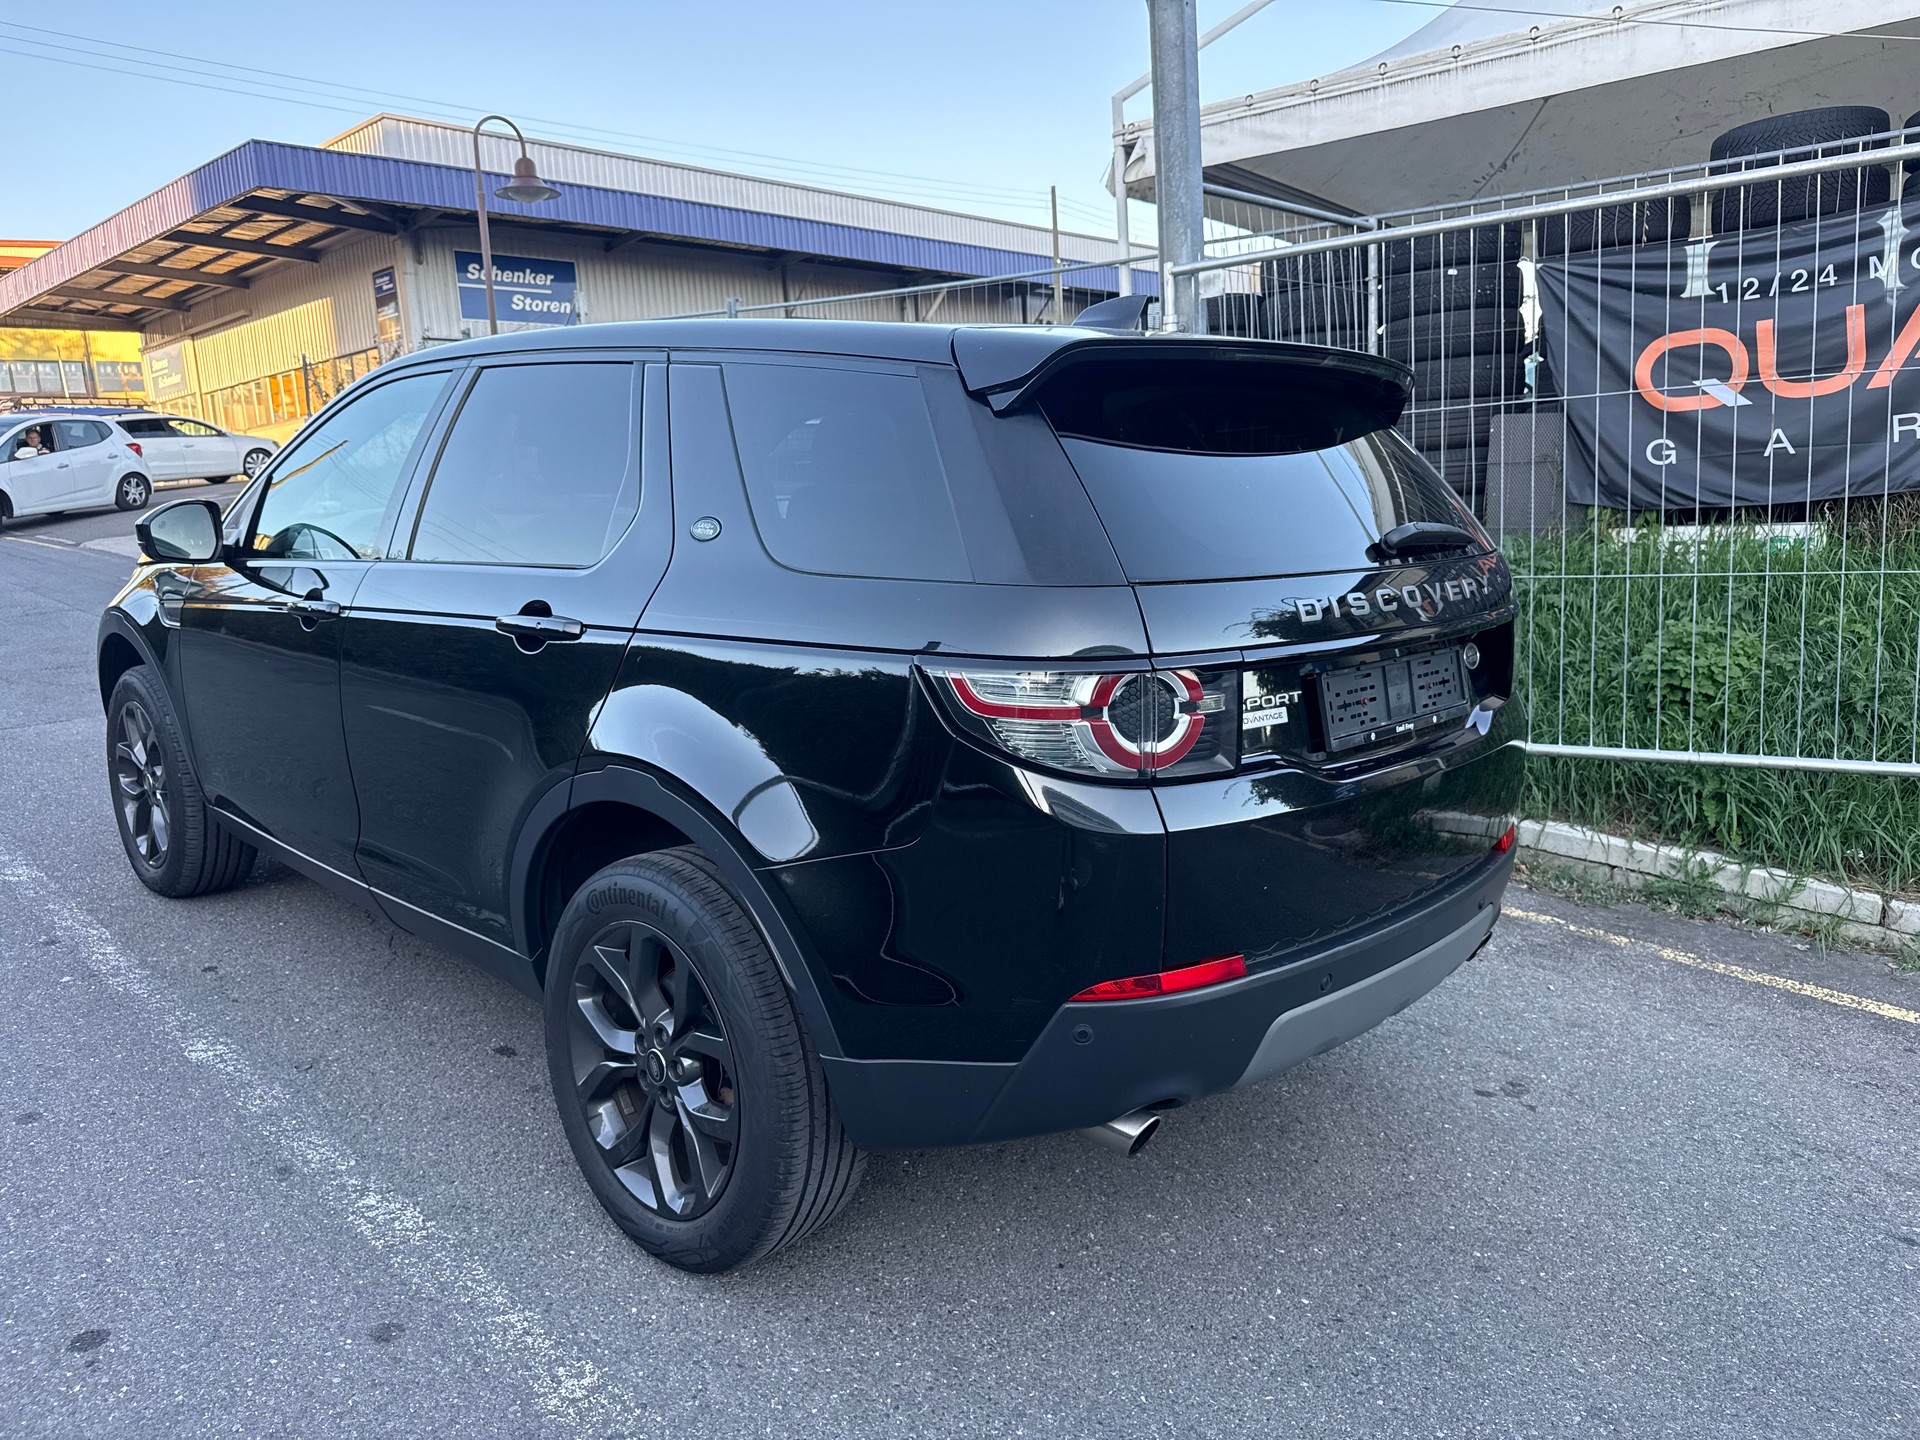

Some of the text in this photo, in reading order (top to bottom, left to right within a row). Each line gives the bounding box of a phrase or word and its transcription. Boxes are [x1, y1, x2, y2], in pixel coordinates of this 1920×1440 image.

[466, 263, 554, 286] Schenker
[1716, 263, 1838, 304] 12/24
[511, 293, 571, 314] Storen
[1294, 574, 1489, 623] DISCOVERY
[1242, 711, 1284, 725] DVANTAGE
[586, 881, 669, 919] Continental
